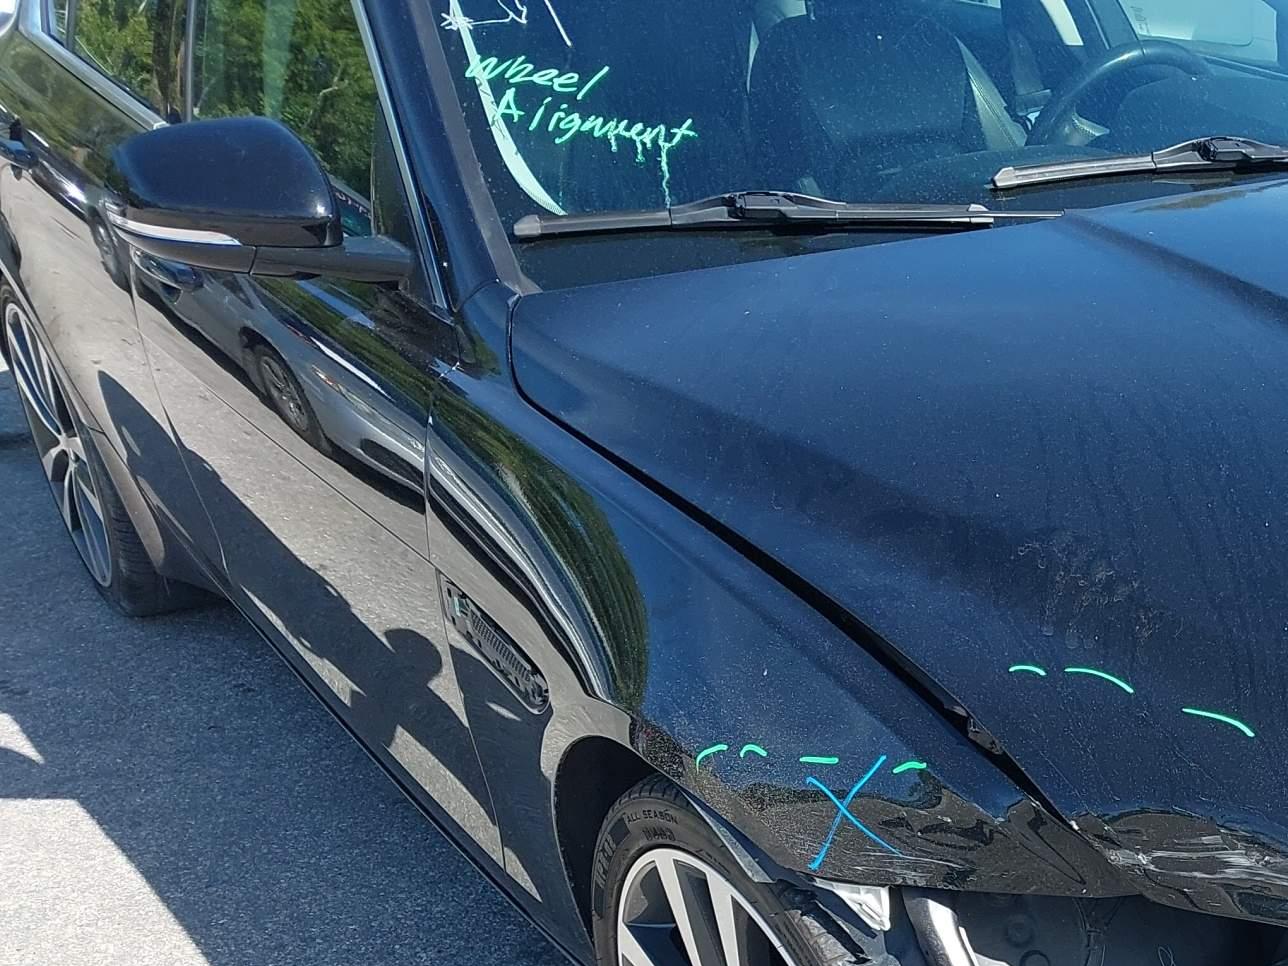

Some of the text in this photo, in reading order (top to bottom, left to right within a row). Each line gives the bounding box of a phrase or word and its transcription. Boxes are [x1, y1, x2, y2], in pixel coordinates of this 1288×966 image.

[491, 86, 699, 150] Alignment
[626, 808, 679, 825] ALL SEASON
